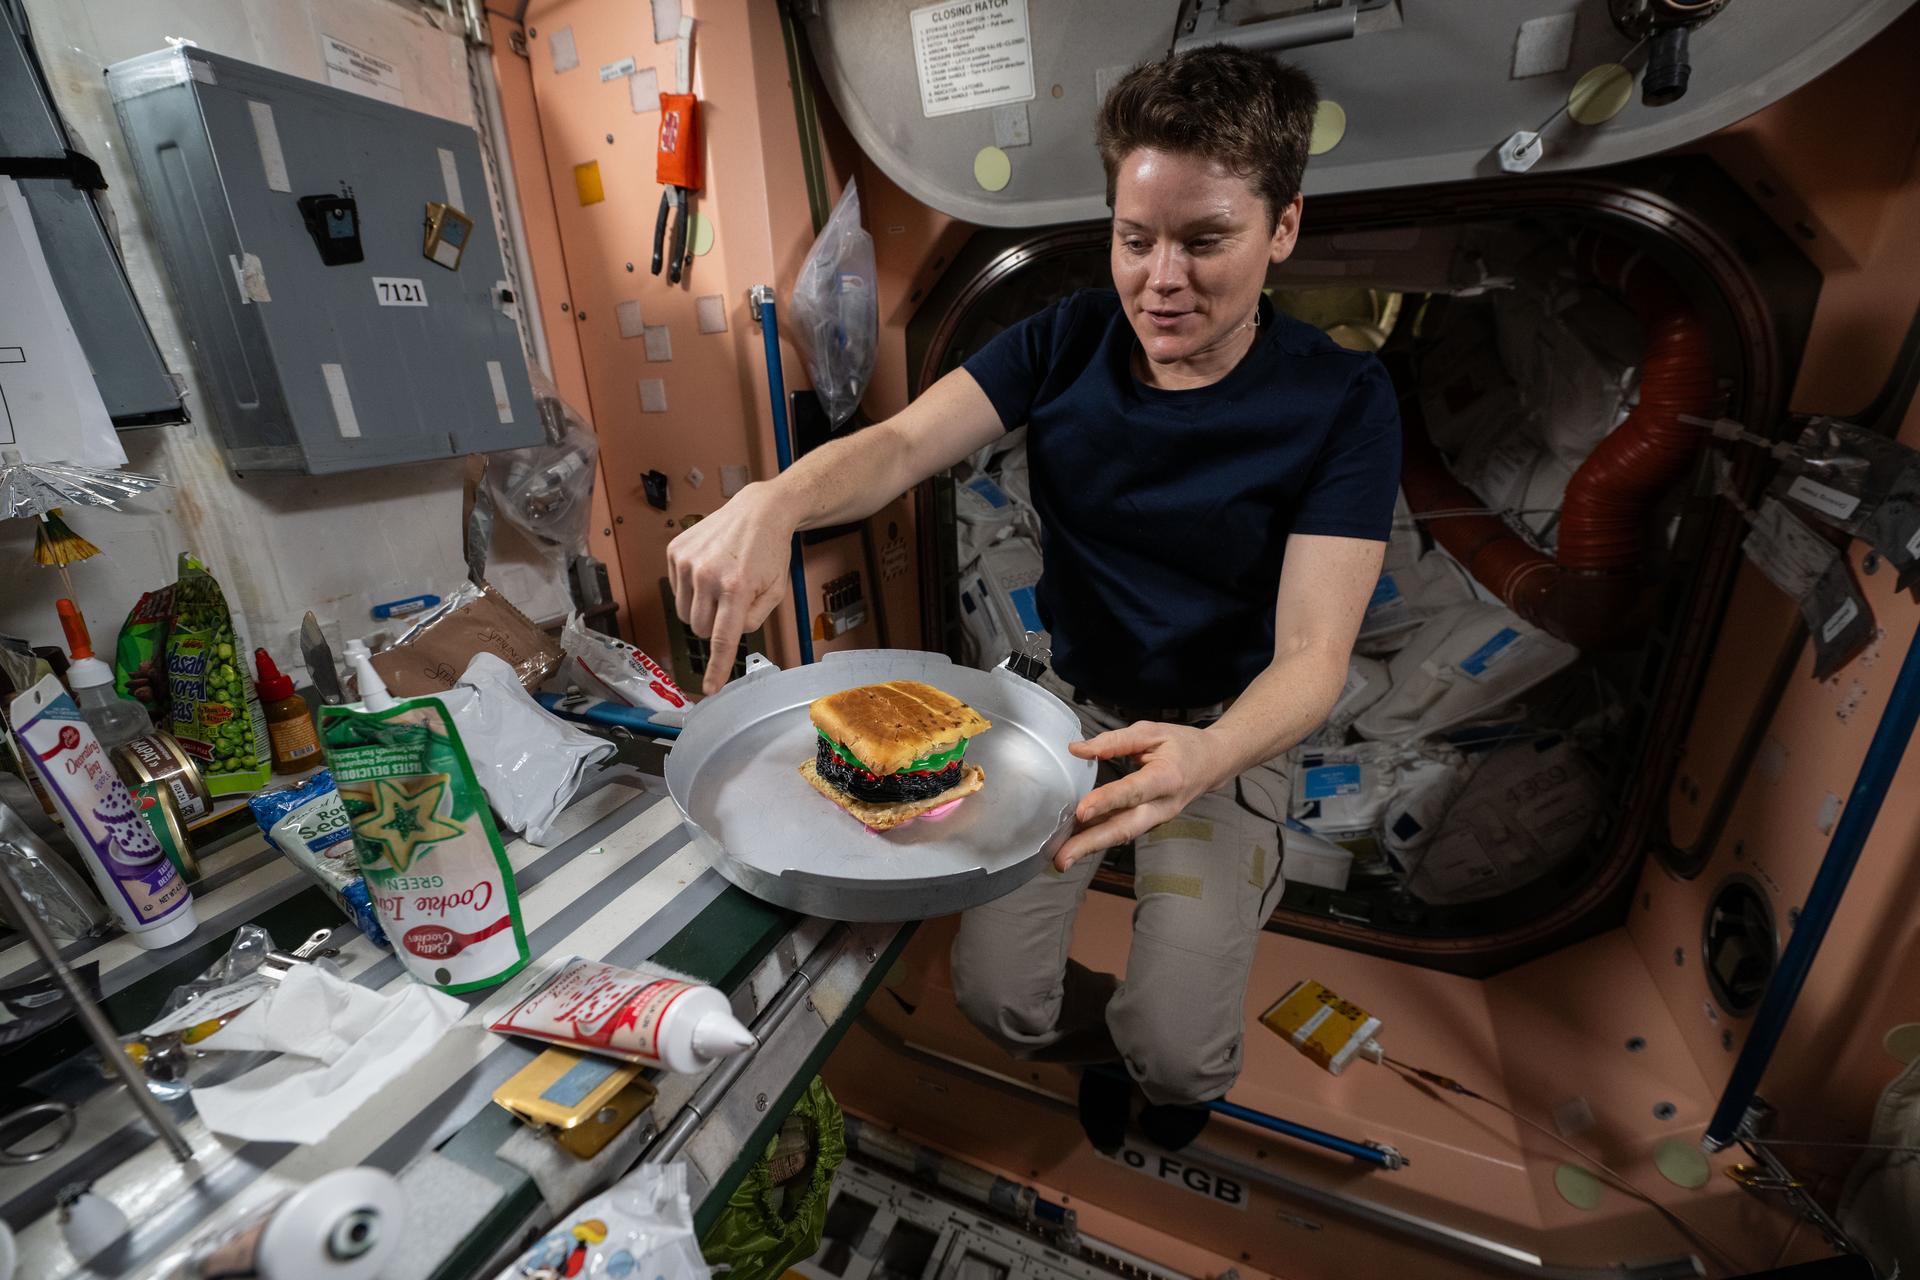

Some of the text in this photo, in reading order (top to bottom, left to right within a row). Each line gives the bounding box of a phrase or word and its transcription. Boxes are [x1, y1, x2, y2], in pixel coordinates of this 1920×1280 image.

[931, 0, 1008, 23] CLOSING HATCH
[378, 283, 422, 302] 7121
[386, 875, 444, 891] GREEN
[415, 880, 493, 918] Cookie
[407, 932, 454, 945] Crocker
[416, 944, 448, 955] Betty
[1158, 1155, 1242, 1204] FGB
